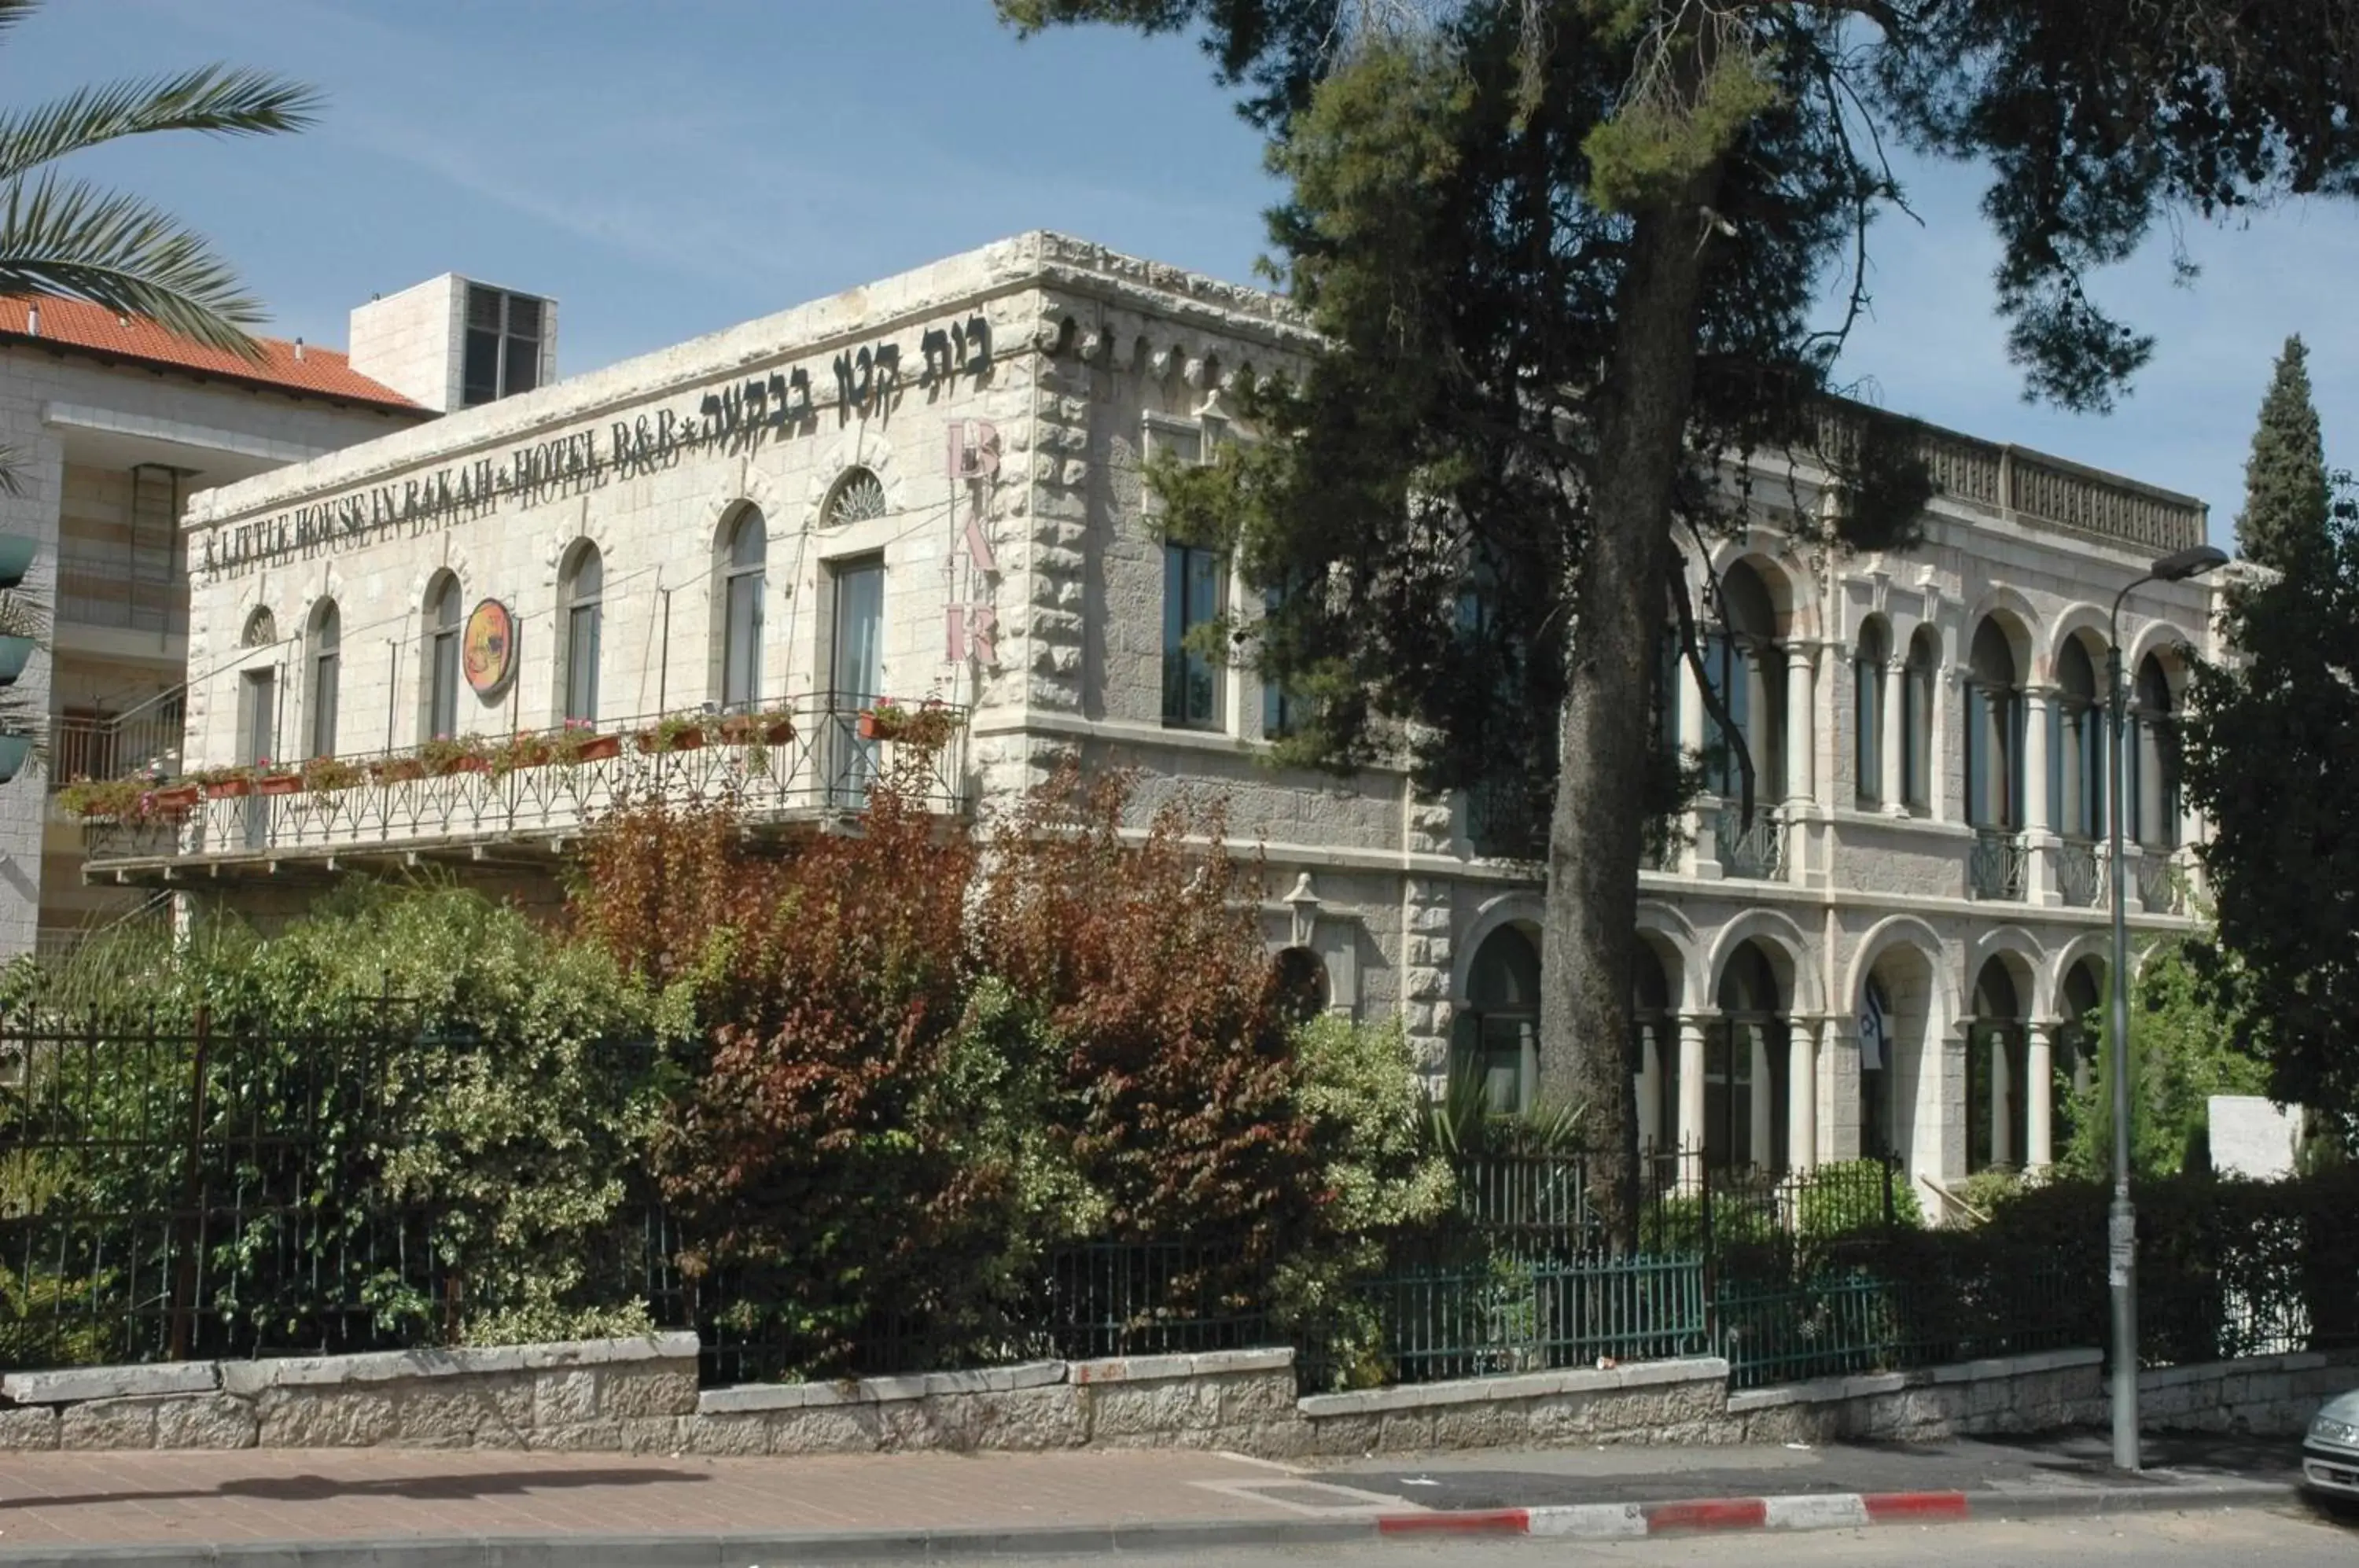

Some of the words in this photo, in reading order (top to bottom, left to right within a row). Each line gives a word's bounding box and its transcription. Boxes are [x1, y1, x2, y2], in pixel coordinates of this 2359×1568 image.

[834, 340, 901, 429] קטן
[918, 313, 992, 389] בית
[699, 365, 813, 450] בבקעה
[204, 533, 219, 573] A
[222, 514, 291, 569] LITTLE
[296, 493, 366, 549] HOUSE
[372, 484, 397, 531] IN
[404, 458, 494, 517] BAKAH
[513, 429, 602, 496] HOTEL
[611, 408, 677, 470] B&B
[946, 419, 999, 665] BAR
